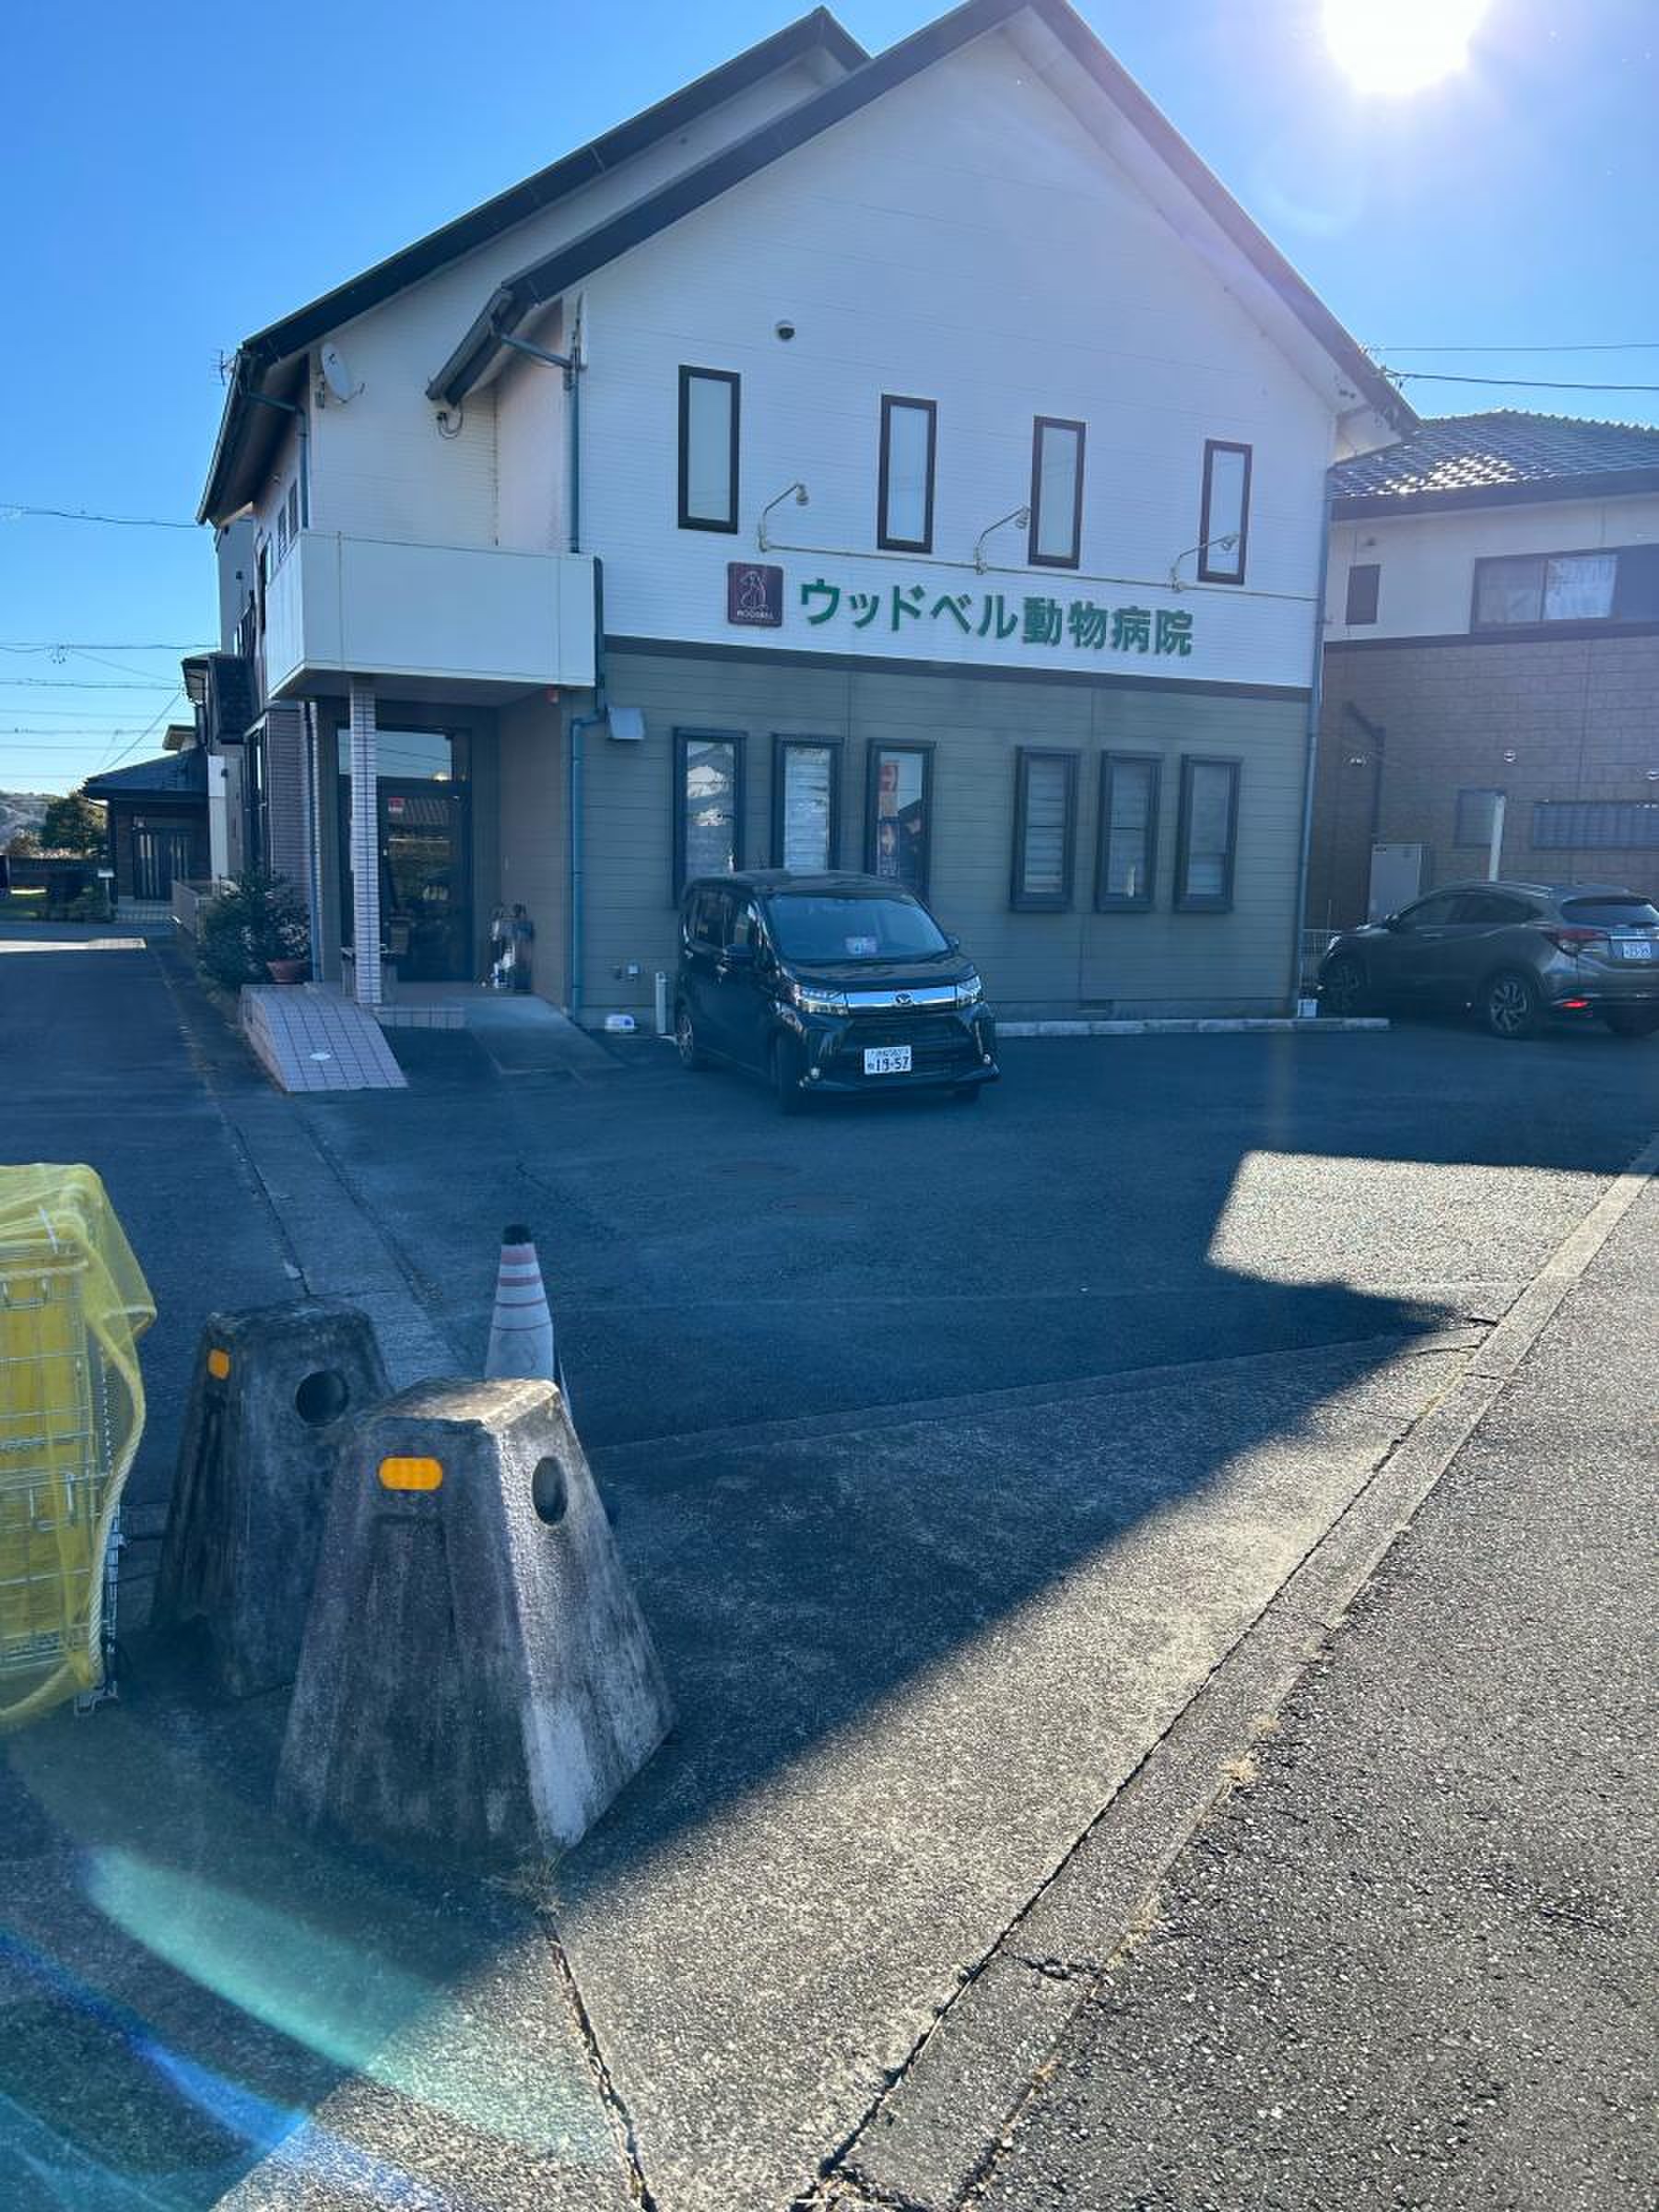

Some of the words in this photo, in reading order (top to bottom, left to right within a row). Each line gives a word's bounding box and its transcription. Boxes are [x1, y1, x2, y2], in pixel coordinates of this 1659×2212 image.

[800, 578, 1194, 656] ウッドベル動物病院
